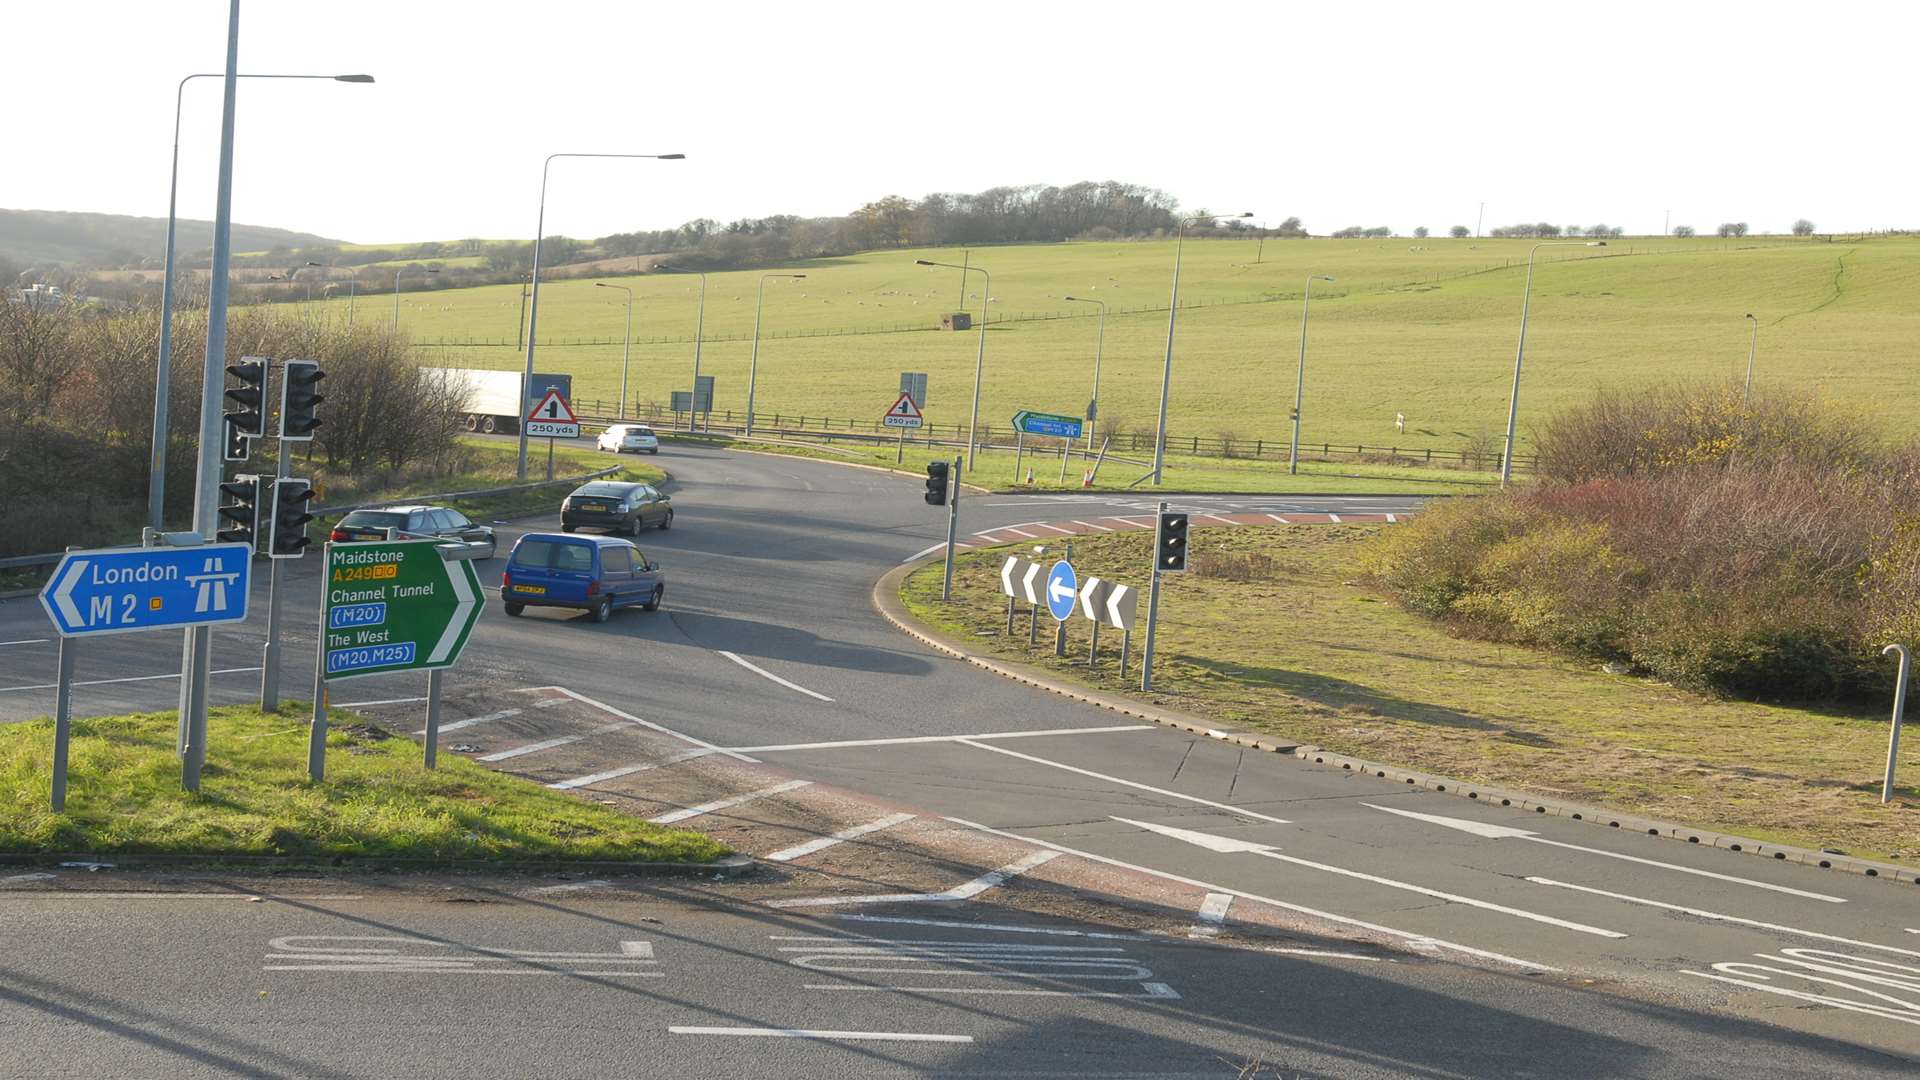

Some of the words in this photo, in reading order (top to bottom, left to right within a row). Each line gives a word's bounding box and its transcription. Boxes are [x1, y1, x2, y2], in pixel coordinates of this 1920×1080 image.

[531, 424, 553, 433] 250
[555, 426, 574, 434] yds
[332, 551, 404, 565] Maidstone
[92, 561, 178, 585] London
[331, 586, 385, 603] Channel
[392, 582, 434, 598] Tunnel
[334, 606, 381, 625] (M20)
[328, 634, 351, 647] The
[356, 629, 390, 644] West
